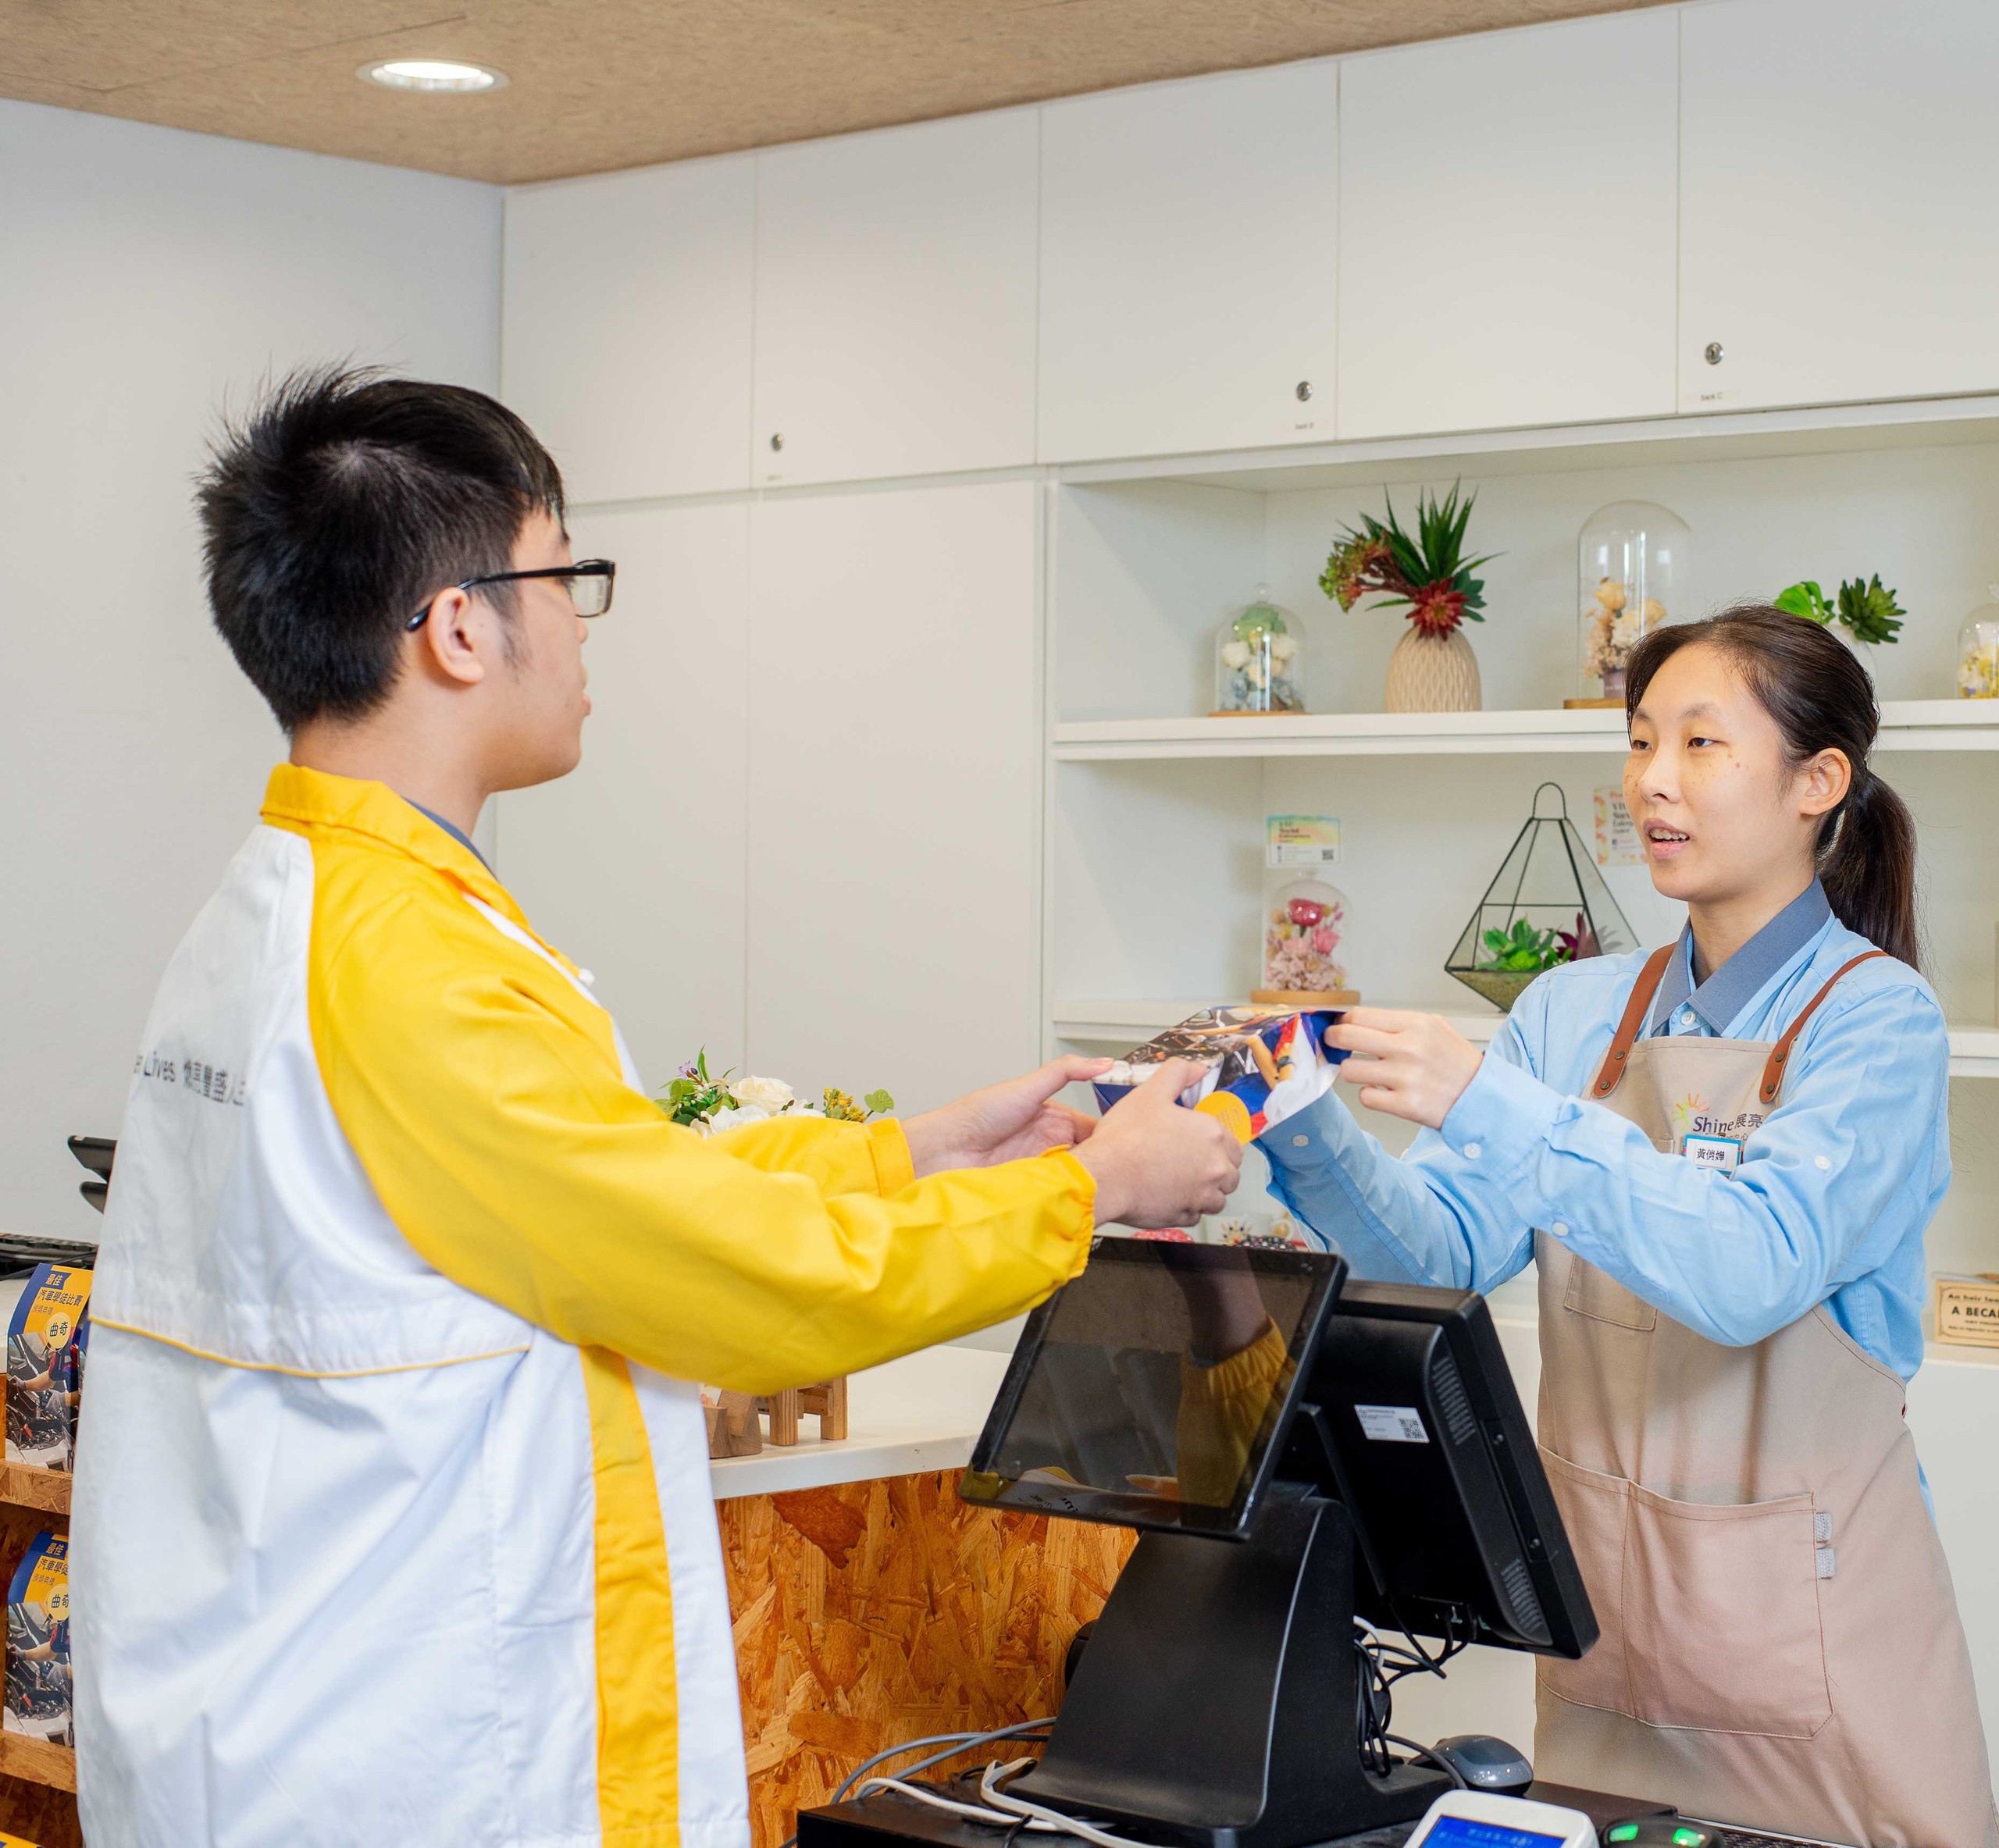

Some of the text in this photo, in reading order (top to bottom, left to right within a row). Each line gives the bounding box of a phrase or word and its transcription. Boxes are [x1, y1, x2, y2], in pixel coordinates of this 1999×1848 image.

[1693, 1116, 1734, 1133] Shine
[1734, 1113, 1764, 1129] 展亮
[45, 1273, 63, 1286] 最佳
[37, 1289, 84, 1307] 汽車學徒比賽
[1952, 1306, 1999, 1318] A BECA
[49, 1321, 68, 1337] 曲奇
[46, 1543, 64, 1556] 最佳
